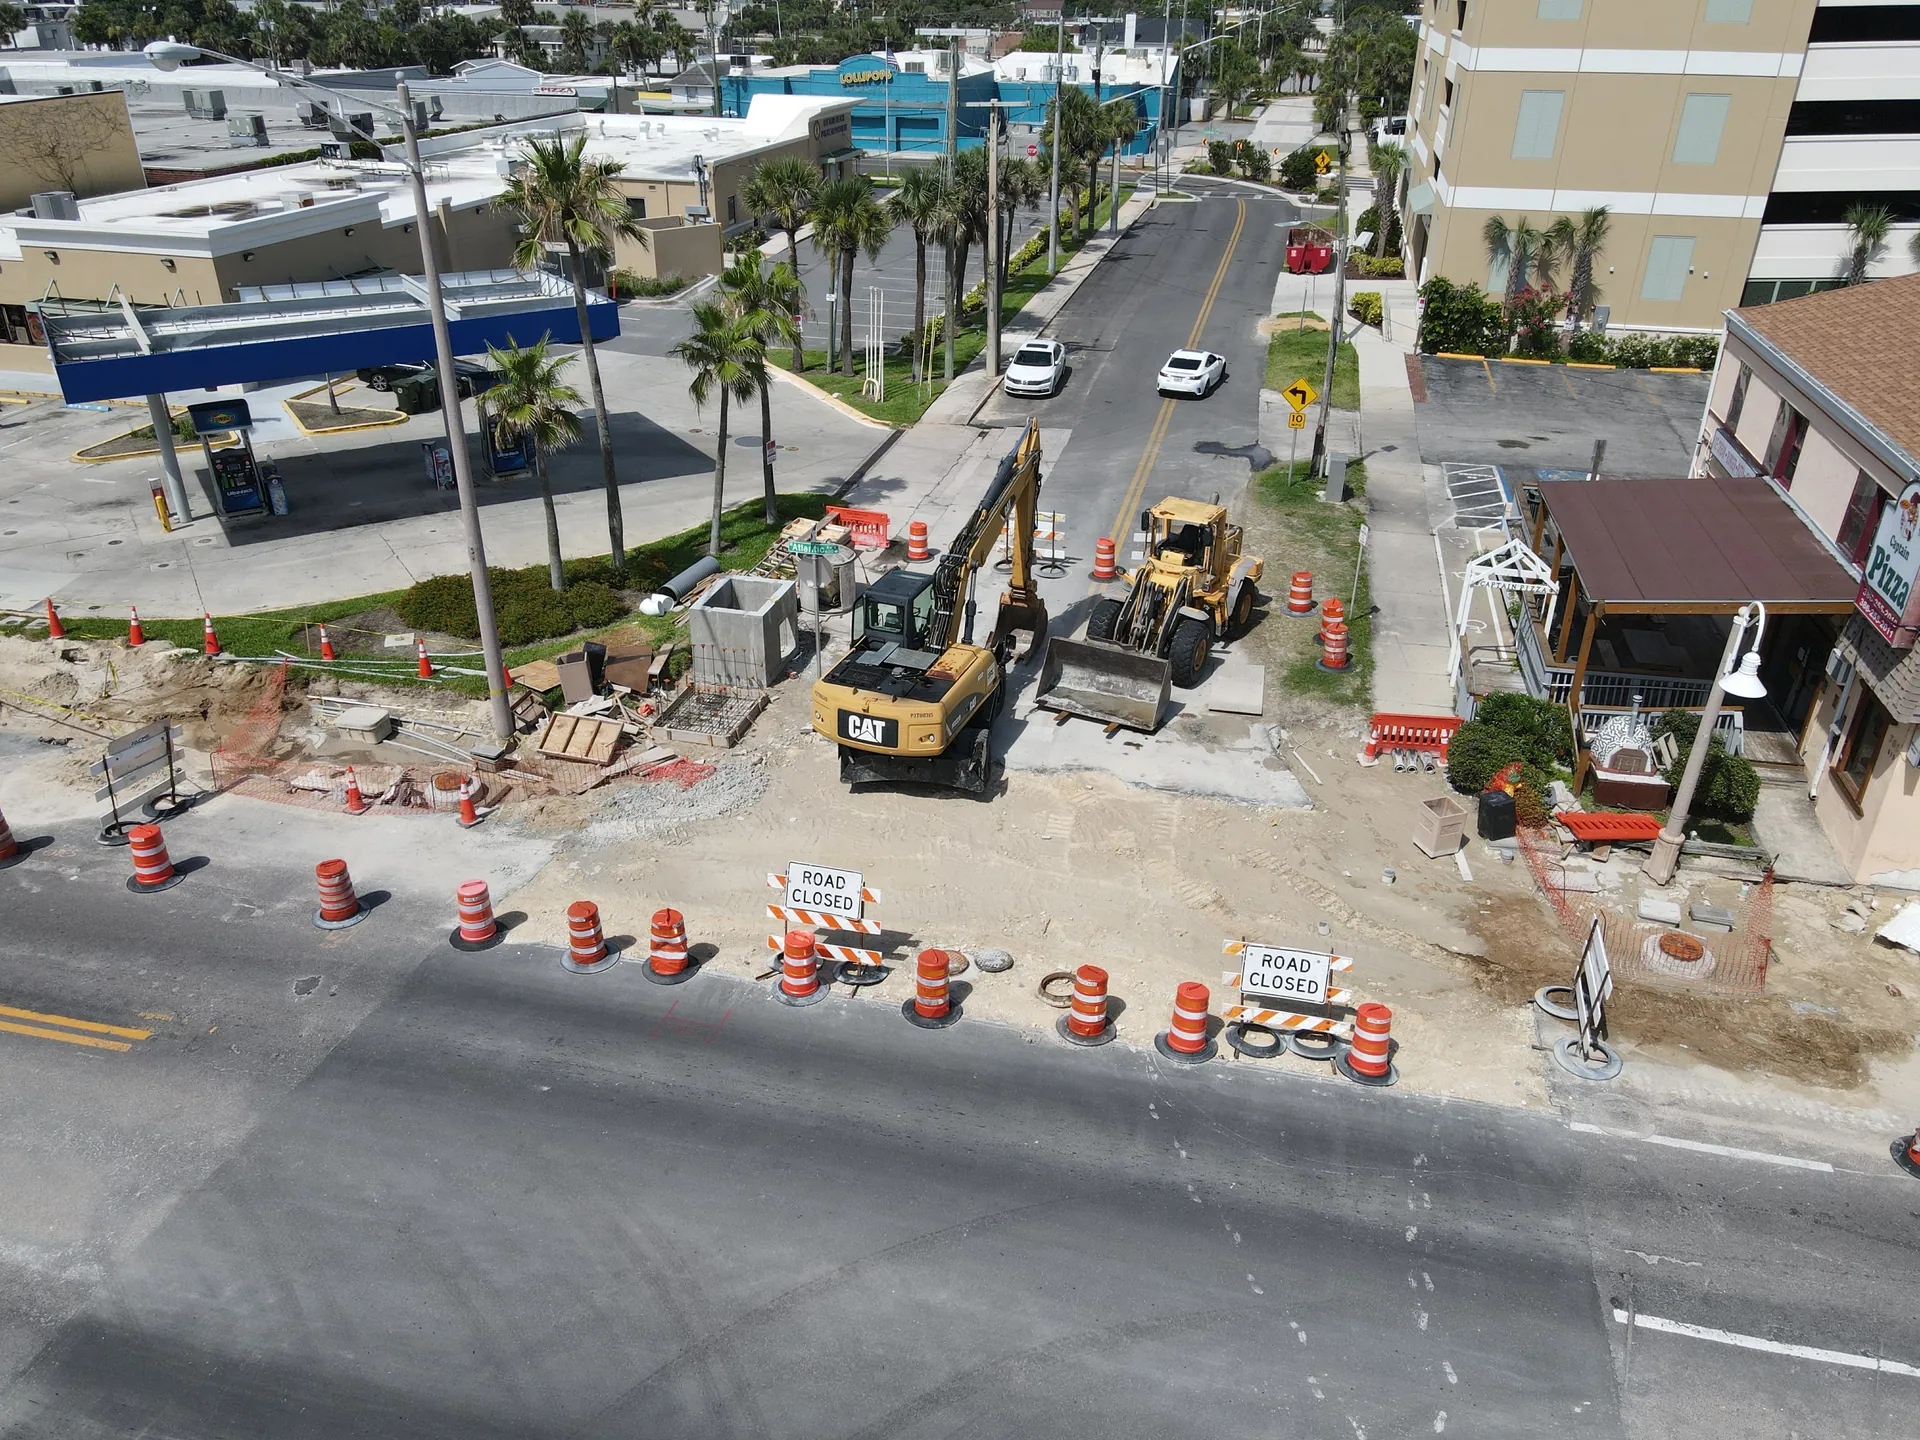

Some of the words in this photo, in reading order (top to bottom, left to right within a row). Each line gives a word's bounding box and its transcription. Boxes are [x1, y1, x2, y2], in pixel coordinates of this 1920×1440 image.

[1292, 414, 1303, 423] 10
[1890, 535, 1910, 561] Captain
[1480, 581, 1516, 590] CAPTAIN
[1520, 584, 1546, 593] PIZZA
[1868, 545, 1910, 610] Pizza
[848, 714, 886, 744] CAT
[802, 870, 846, 890] ROAD
[792, 888, 853, 911] CLOSED
[1261, 953, 1311, 973] ROAD
[1249, 972, 1319, 994] CLOSED
